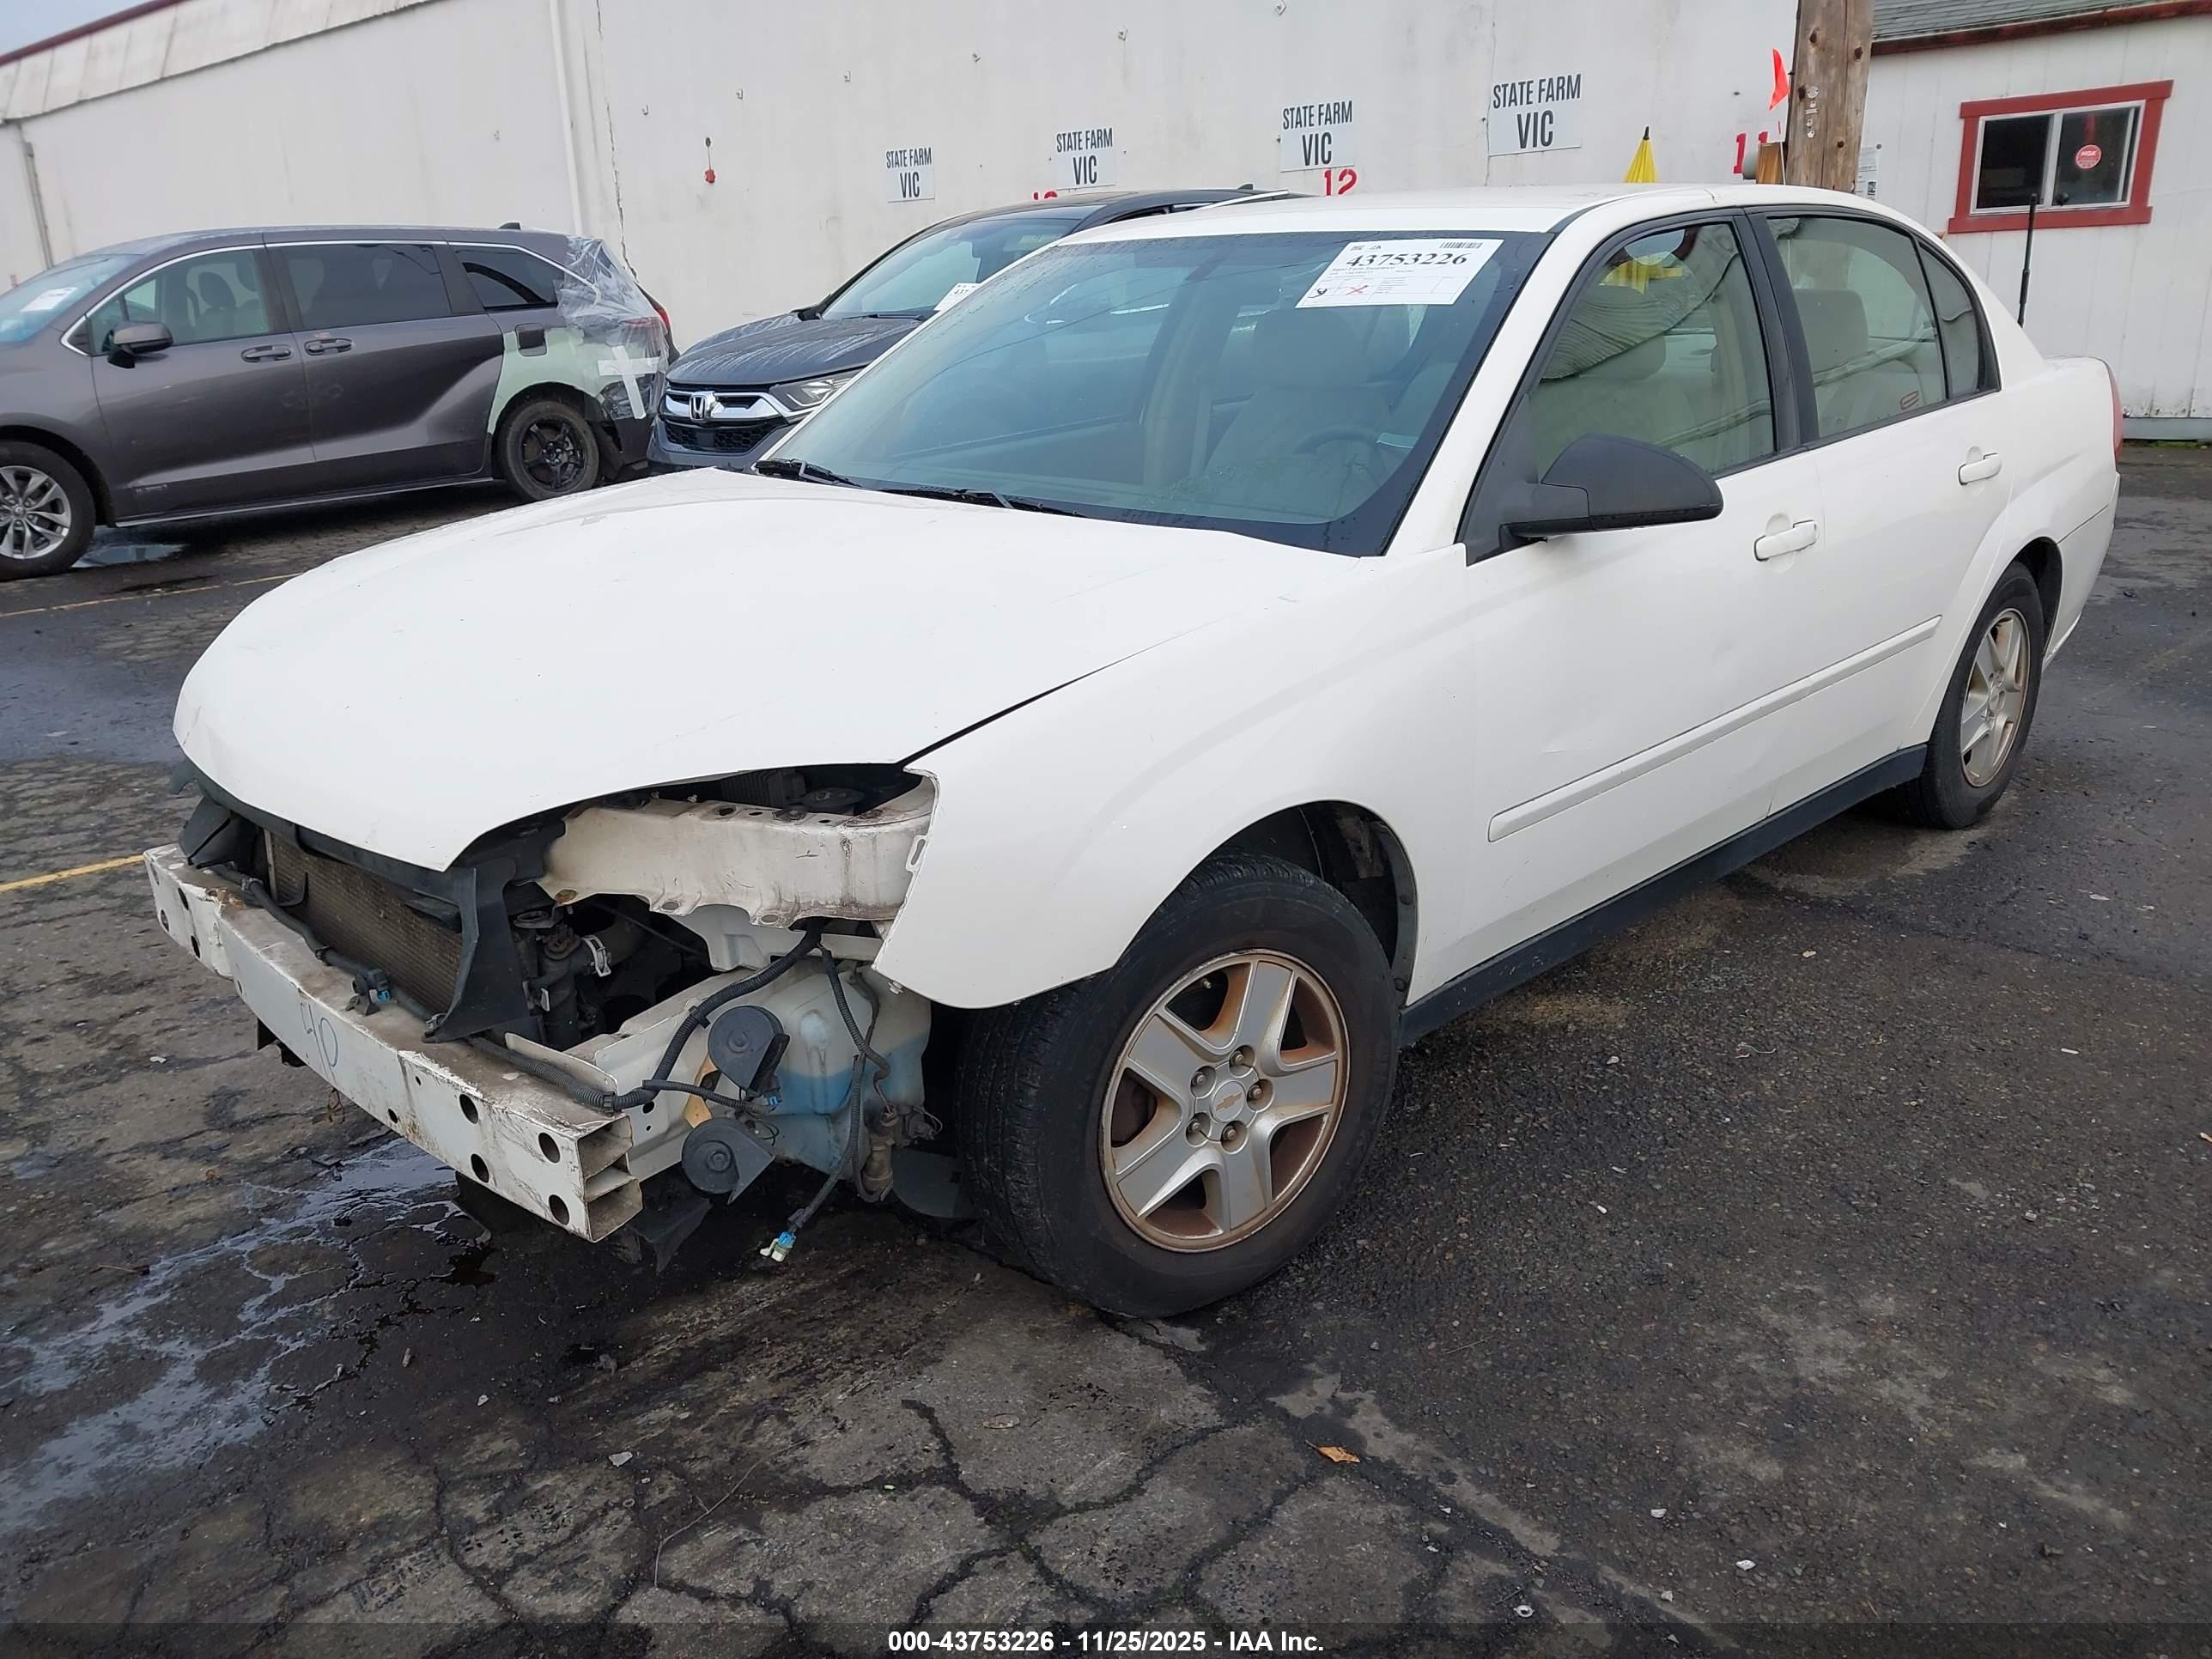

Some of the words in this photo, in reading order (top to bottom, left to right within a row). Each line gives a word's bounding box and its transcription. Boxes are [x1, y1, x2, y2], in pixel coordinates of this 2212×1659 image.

[1492, 80, 1534, 109] STATE
[1537, 73, 1582, 103] FARM
[1282, 104, 1316, 131] STATE
[1318, 100, 1353, 127] FARM
[1516, 109, 1554, 149] VIC
[1056, 131, 1083, 154] STATE
[1085, 127, 1113, 150] FARM
[1302, 131, 1333, 167] VIC
[886, 149, 908, 169] STATE
[909, 147, 933, 167] FARM
[1073, 155, 1097, 185] VIC
[900, 171, 921, 199] VIC
[1346, 252, 1468, 267] 43753226
